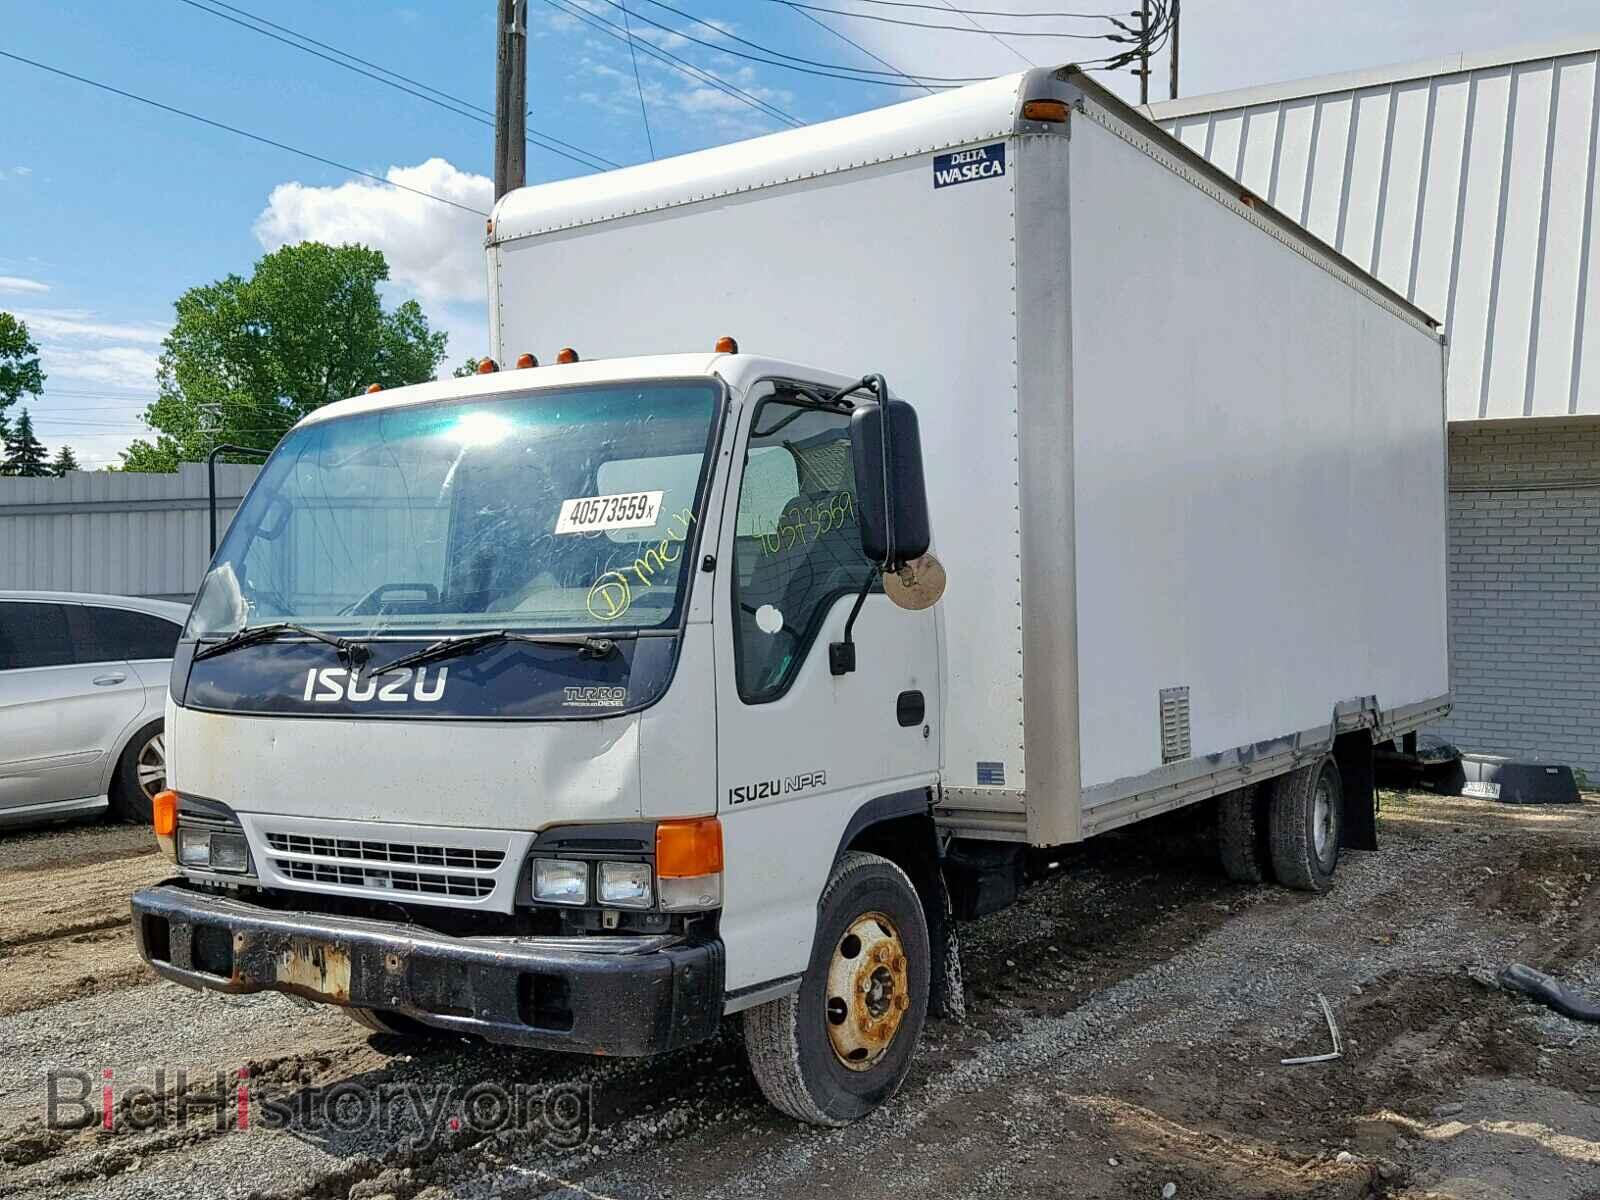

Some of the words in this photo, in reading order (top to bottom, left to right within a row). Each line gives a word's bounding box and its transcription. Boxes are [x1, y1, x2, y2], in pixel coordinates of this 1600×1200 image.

[951, 148, 987, 165] DELTA
[935, 160, 1003, 185] WASECA
[303, 666, 449, 702] ISUZU
[563, 686, 626, 701] TURBO
[728, 779, 781, 805] ISUZU
[784, 769, 827, 794] NPR
